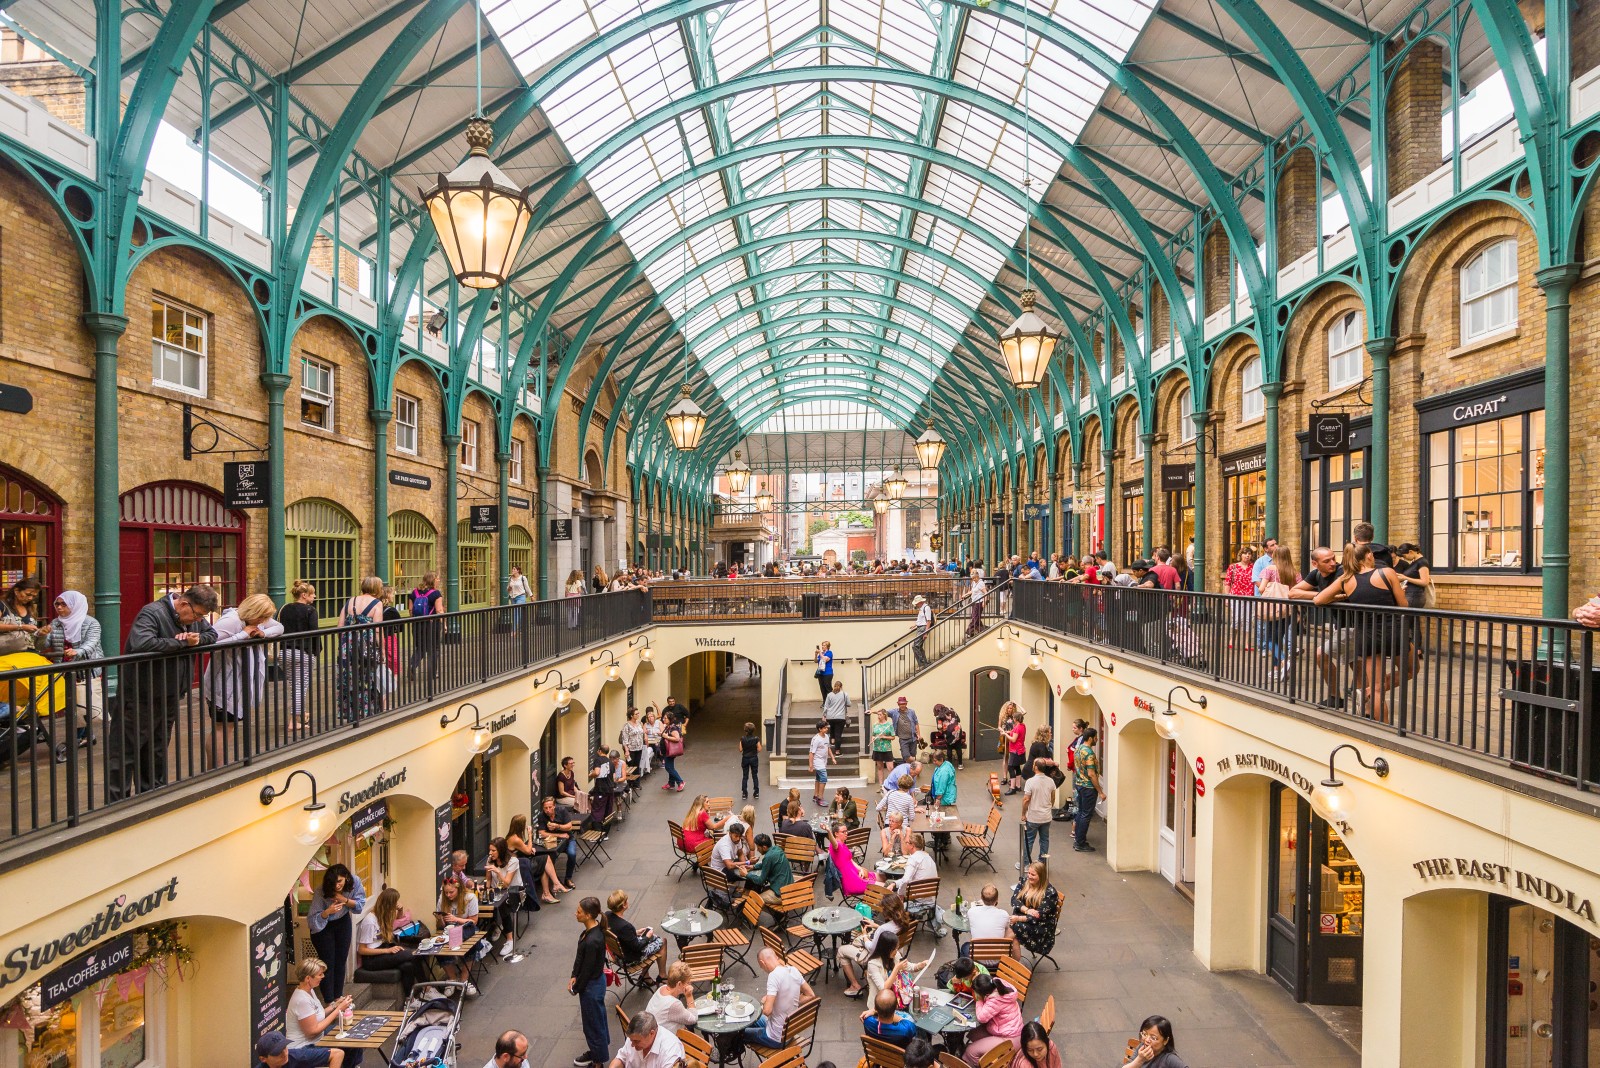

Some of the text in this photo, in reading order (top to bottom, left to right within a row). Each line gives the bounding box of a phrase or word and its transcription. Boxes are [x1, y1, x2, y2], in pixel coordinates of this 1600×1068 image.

[1236, 455, 1262, 472] Venchi
[1131, 485, 1144, 496] Vench
[695, 637, 736, 647] Whittard
[491, 709, 517, 734] Italiani
[1235, 753, 1259, 766] EAST
[1260, 755, 1291, 781] INDIA
[338, 766, 408, 815] Sweetheart
[1413, 857, 1597, 924] THE EAST INDIA
[0, 876, 179, 989] Sweetheart
[100, 959, 107, 970] &
[108, 946, 130, 967] LOVE
